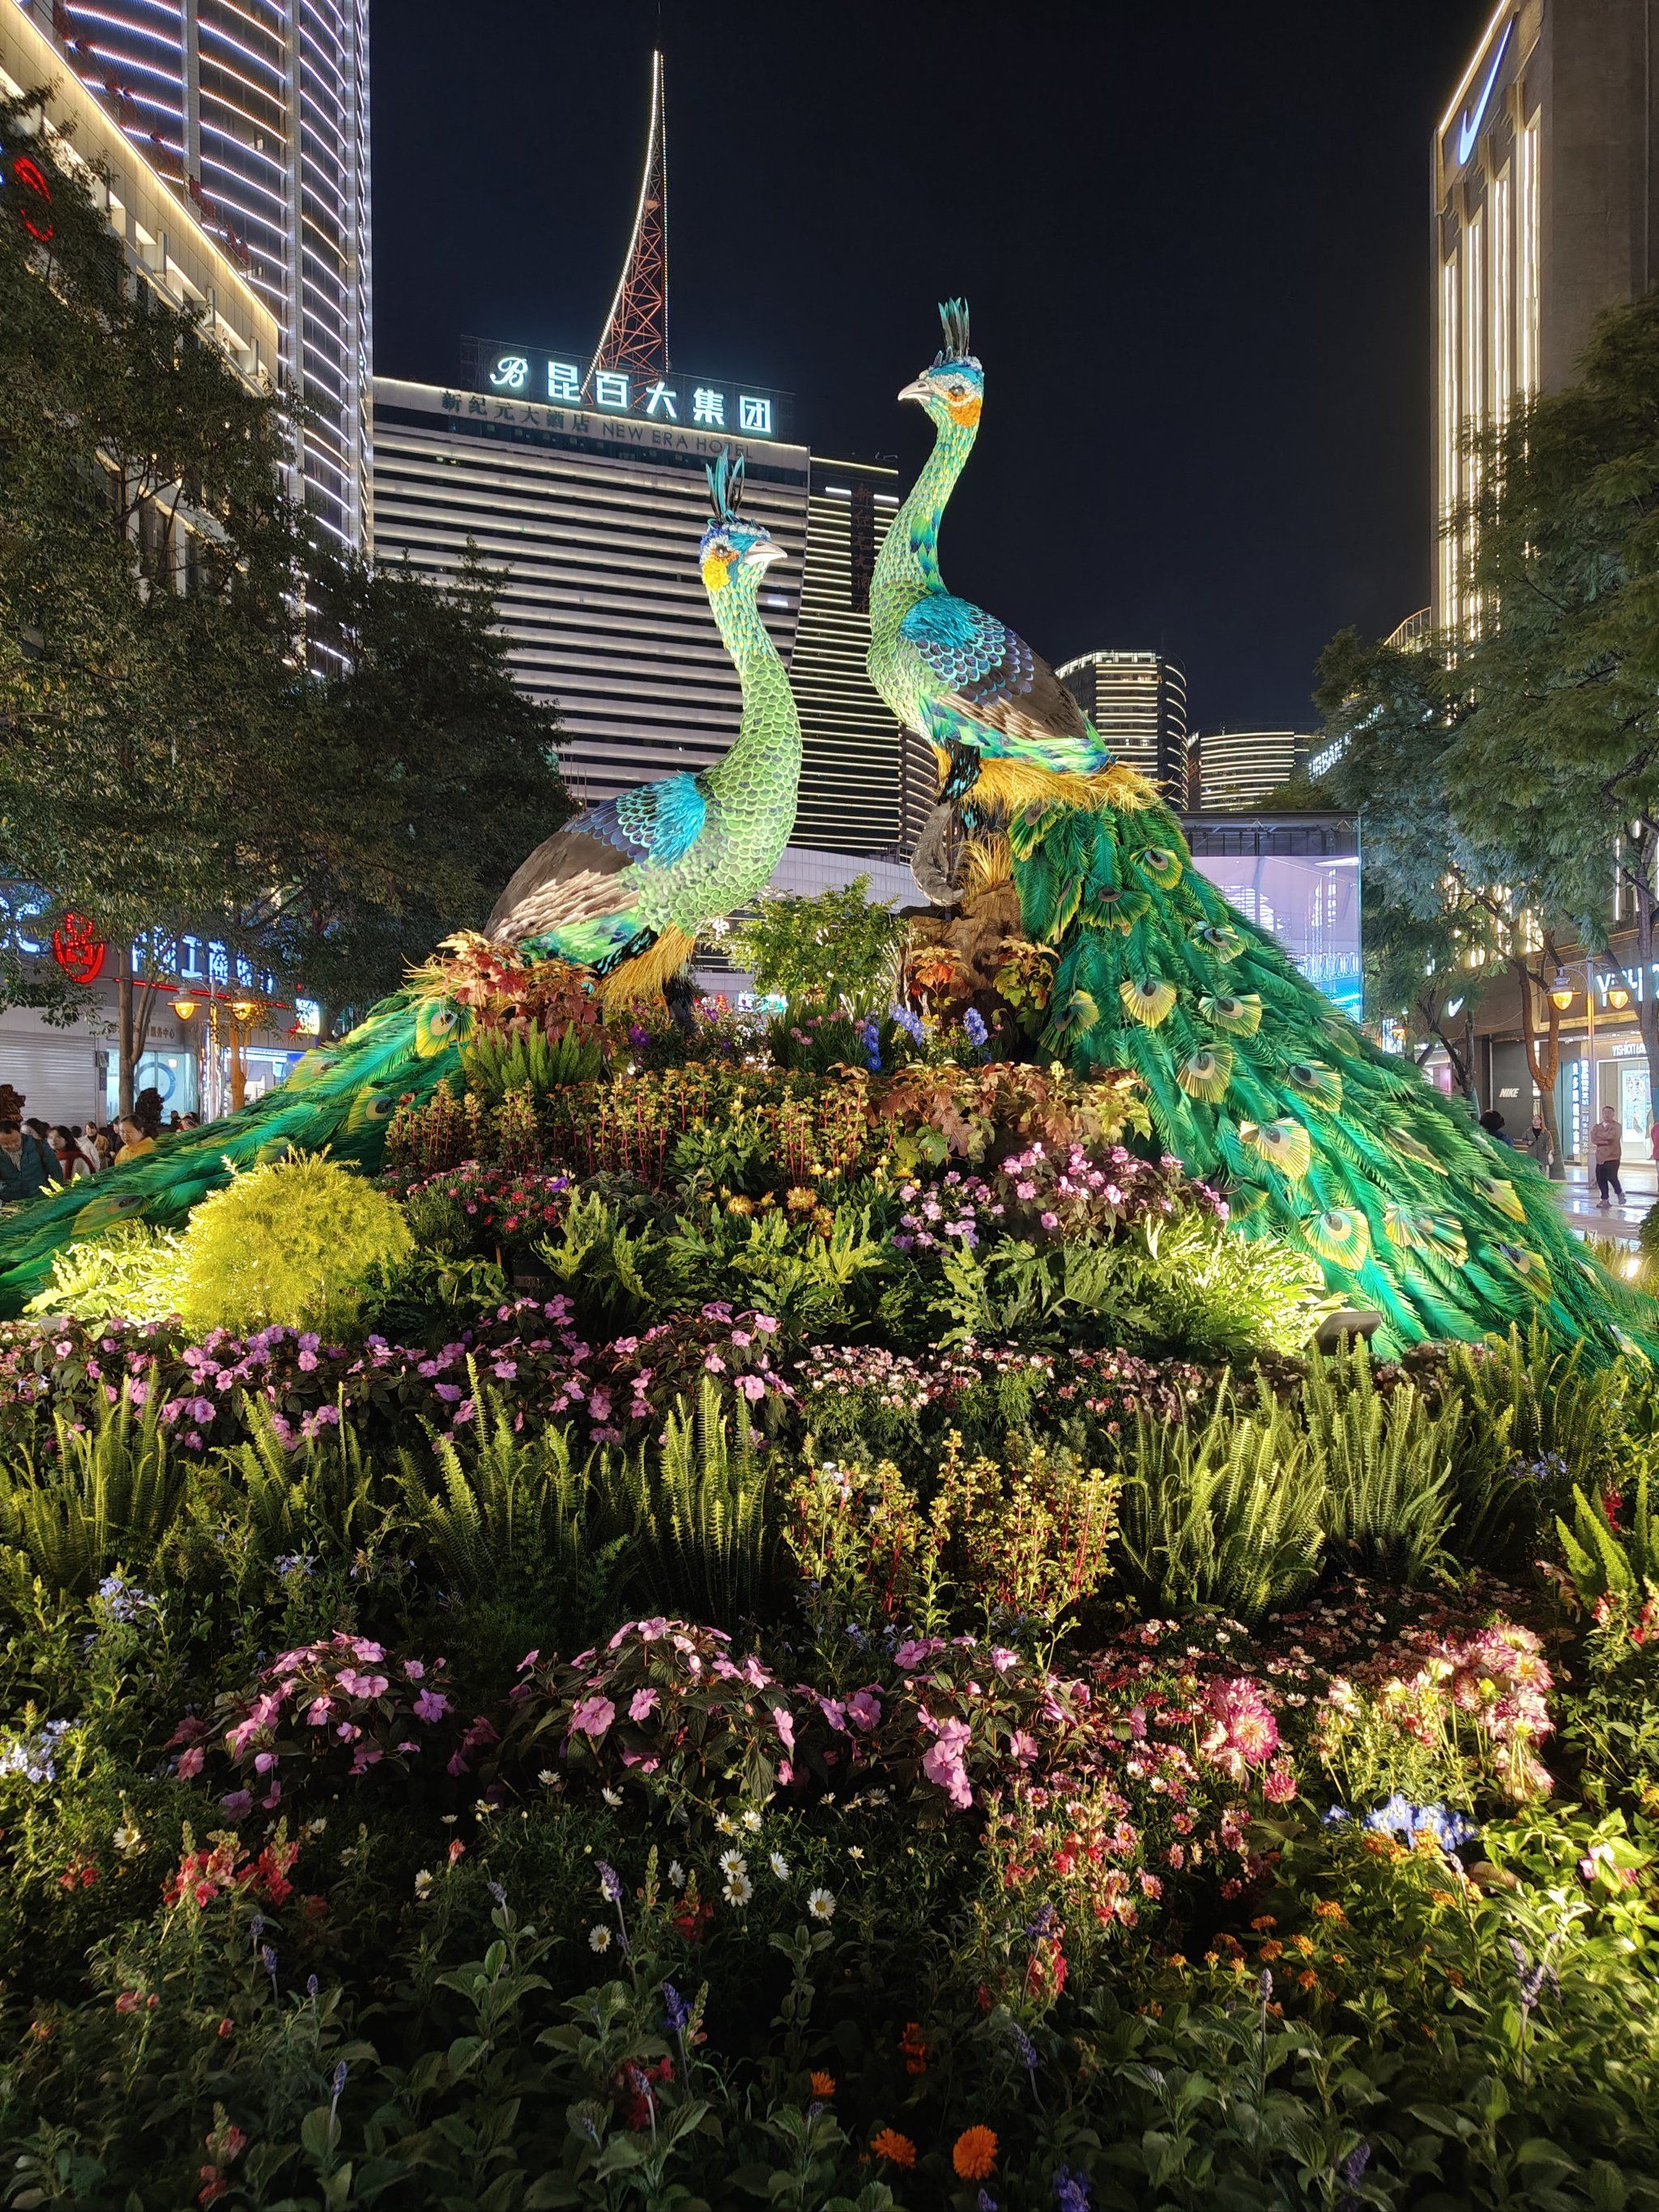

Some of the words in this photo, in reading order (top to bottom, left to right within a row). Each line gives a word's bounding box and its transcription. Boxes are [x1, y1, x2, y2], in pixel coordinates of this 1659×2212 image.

[441, 390, 591, 433] 新纪元大酒店
[603, 423, 643, 441] NEW
[652, 430, 688, 450] ERA
[697, 437, 753, 459] HOTEL
[548, 361, 771, 433] 昆百大集团
[1499, 1088, 1520, 1098] NIKE
